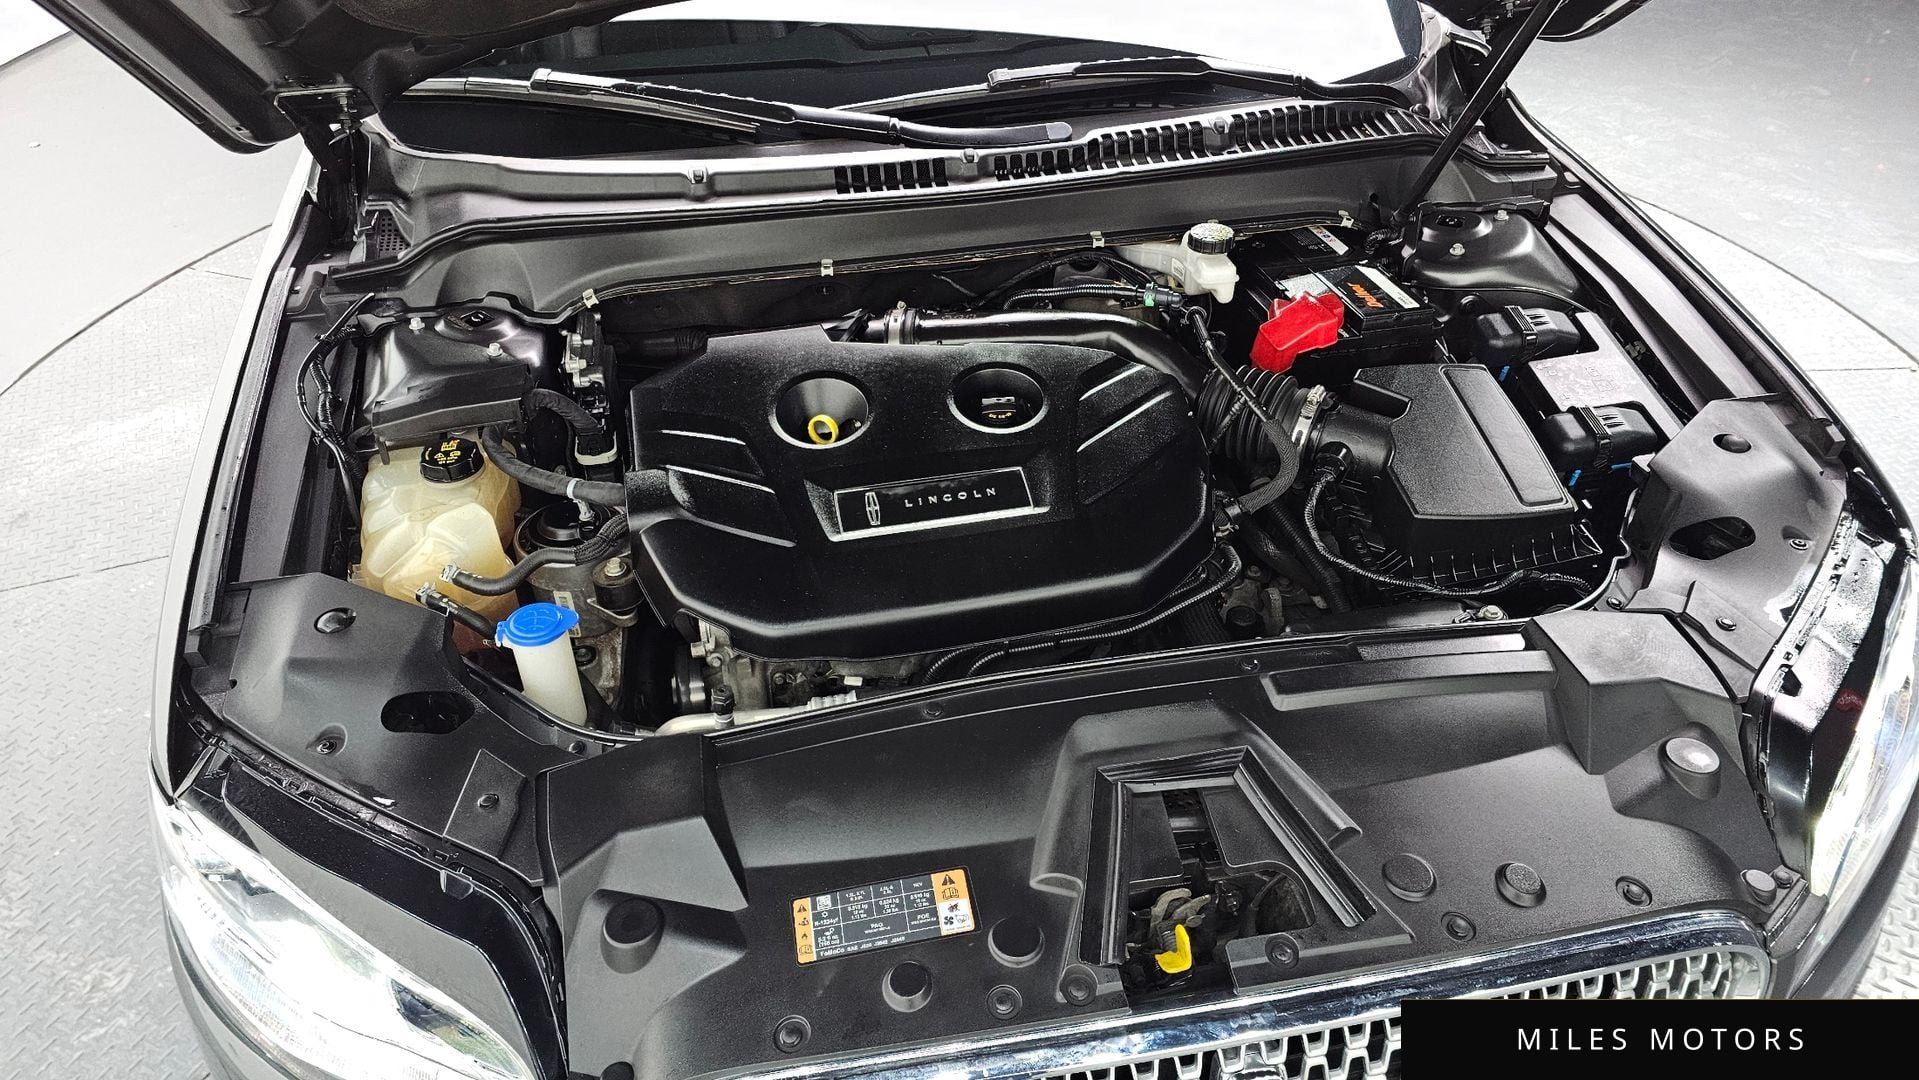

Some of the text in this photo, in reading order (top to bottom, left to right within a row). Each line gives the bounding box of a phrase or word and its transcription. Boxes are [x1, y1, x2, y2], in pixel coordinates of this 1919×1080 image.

[904, 487, 996, 508] LINCOLN
[814, 918, 839, 927] R-1234yf
[820, 948, 845, 957] FoMoCo
